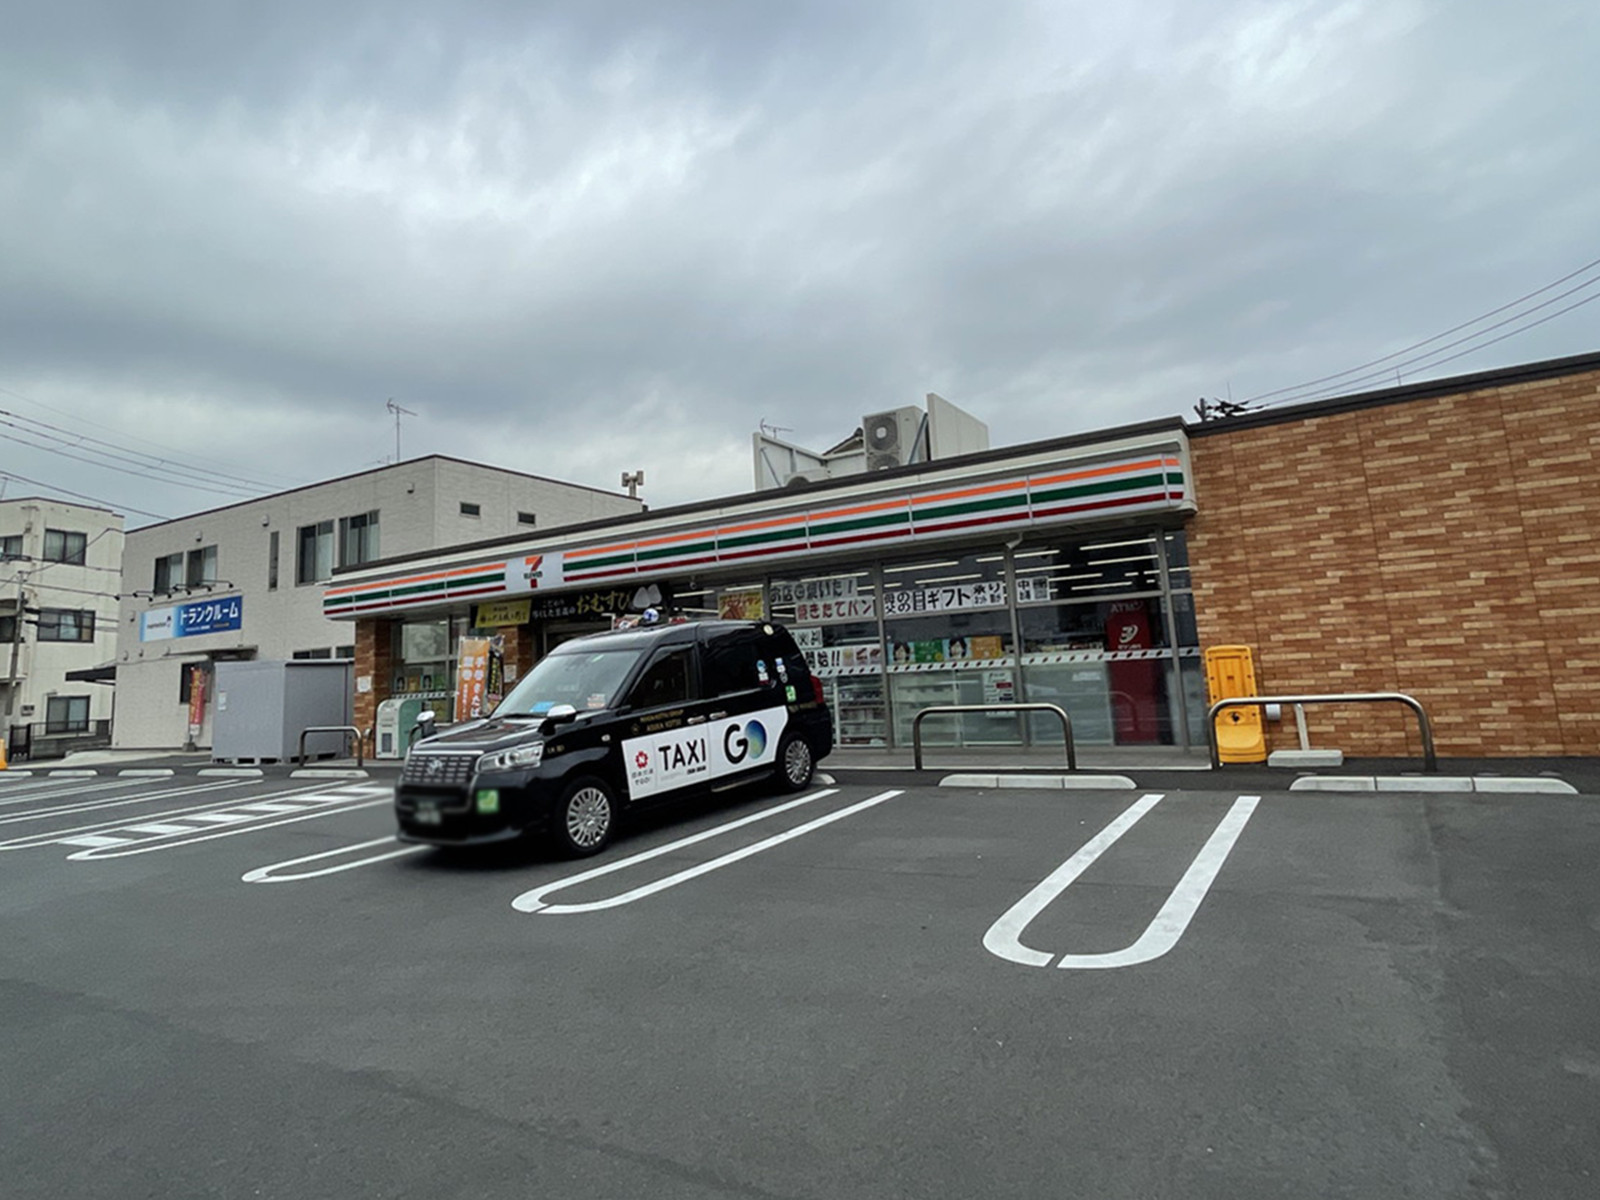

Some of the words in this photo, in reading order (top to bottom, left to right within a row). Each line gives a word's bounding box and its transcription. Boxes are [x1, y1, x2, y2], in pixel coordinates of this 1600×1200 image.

[181, 602, 239, 626] トランクルーム
[658, 738, 706, 771] TAXI
[724, 719, 767, 764] GO
